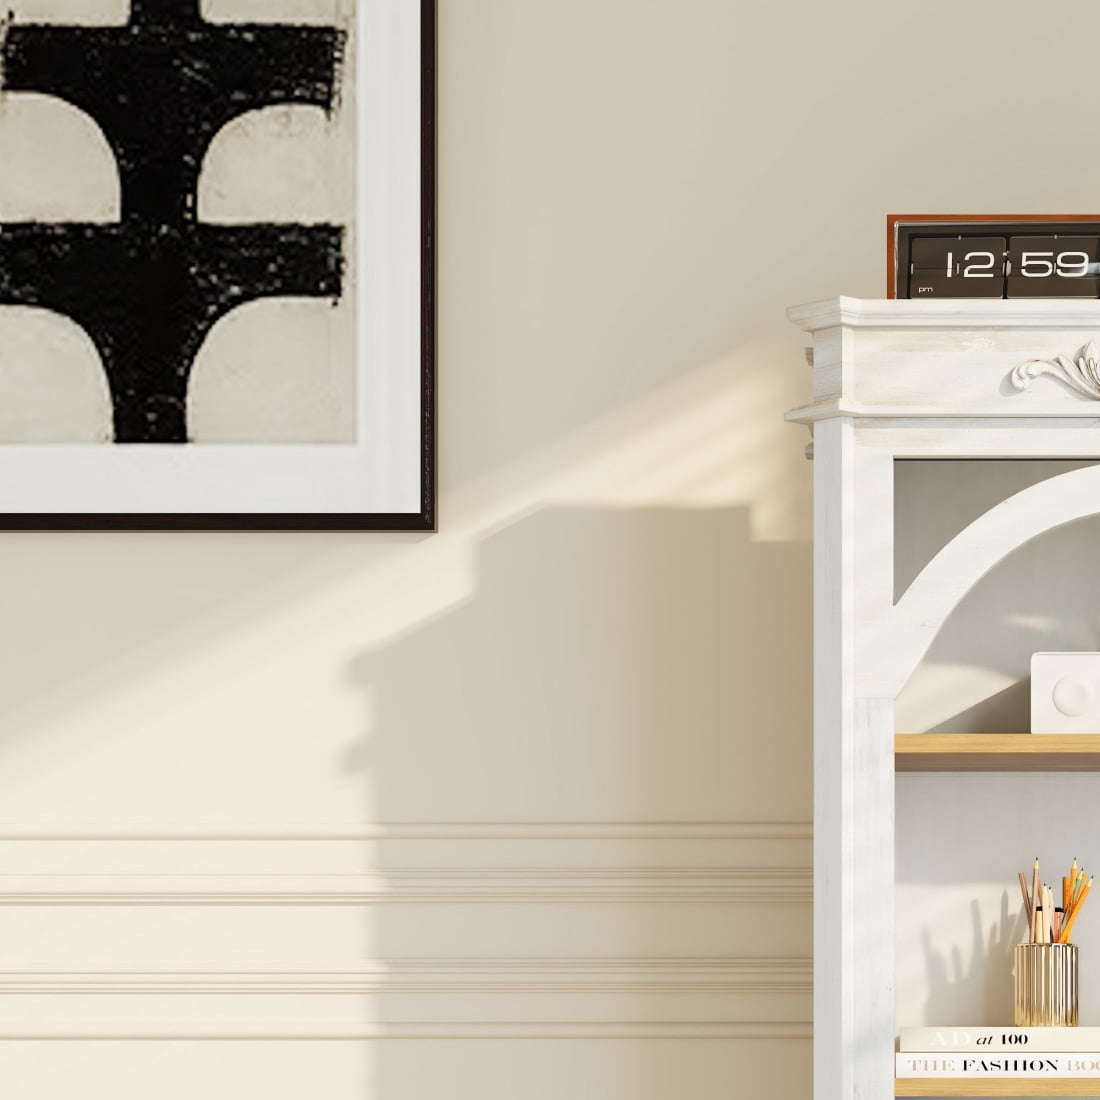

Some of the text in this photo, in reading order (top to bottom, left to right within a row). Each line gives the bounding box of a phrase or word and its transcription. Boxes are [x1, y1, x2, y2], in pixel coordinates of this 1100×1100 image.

[918, 286, 934, 294] pm
[976, 1033, 994, 1046] at
[1001, 1033, 1029, 1046] 100
[907, 1059, 955, 1072] THE
[963, 1059, 1059, 1072] FASHION
